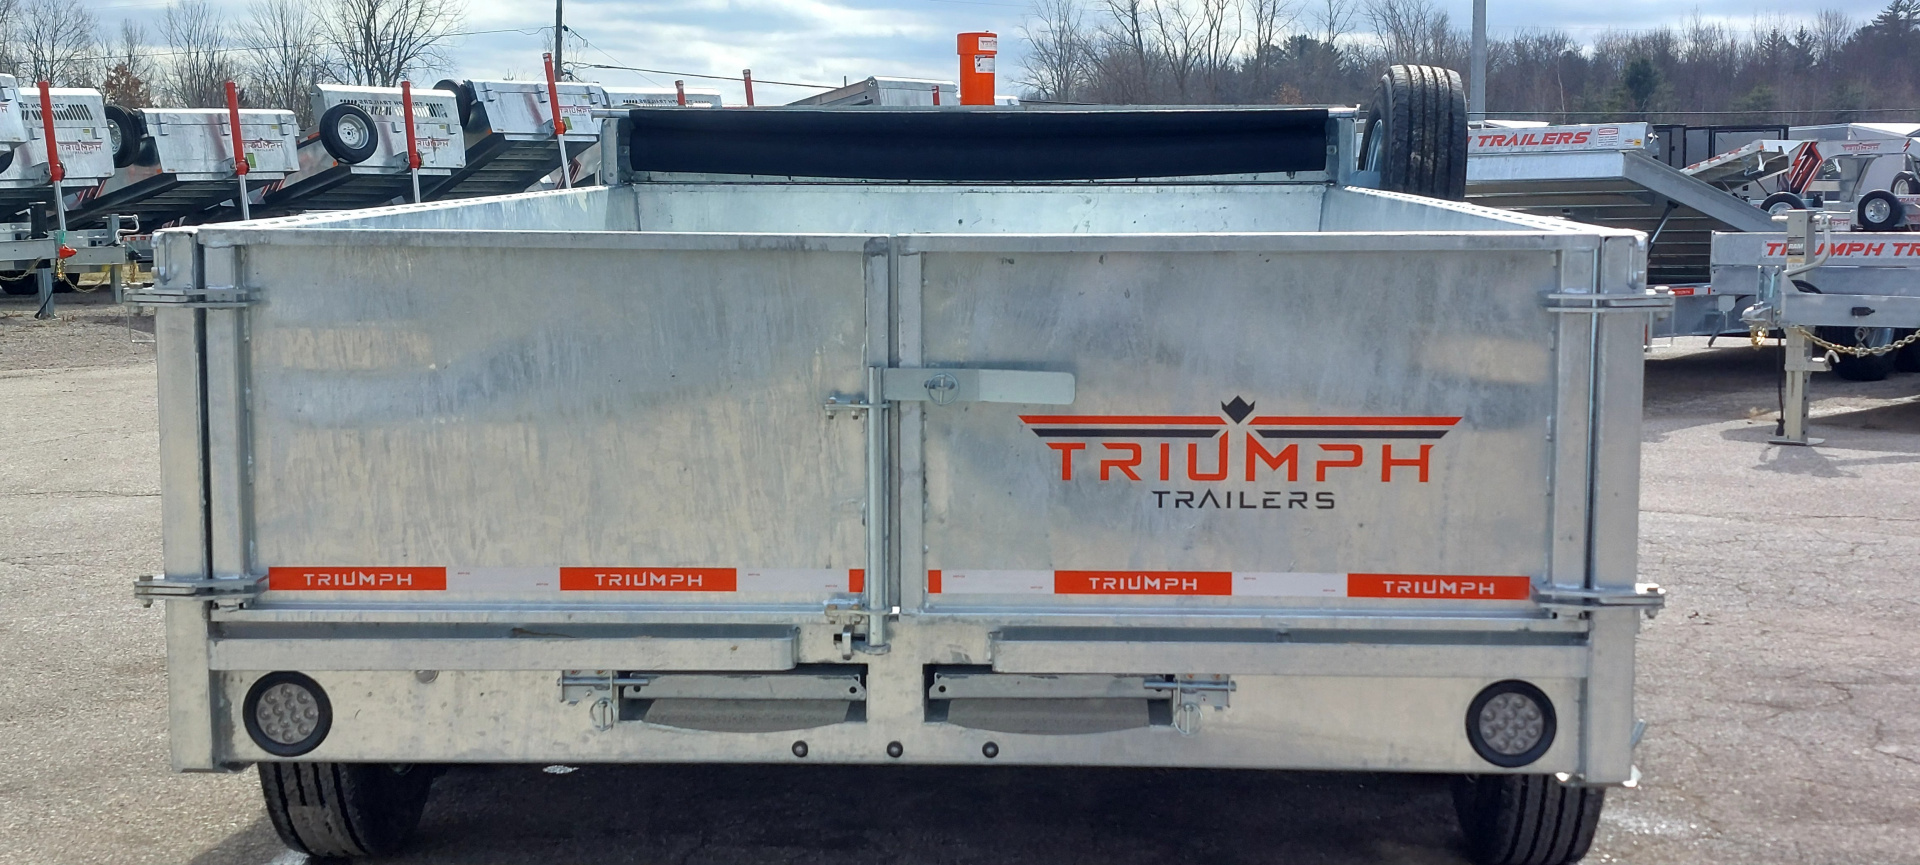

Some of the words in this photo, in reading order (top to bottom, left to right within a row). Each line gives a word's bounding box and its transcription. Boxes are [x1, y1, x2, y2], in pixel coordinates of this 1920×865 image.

[416, 140, 449, 148] RIUMPH
[1478, 131, 1592, 147] TRAILERS
[1046, 431, 1435, 483] TRIUMPH
[1151, 488, 1336, 510] TRAILERS
[303, 570, 413, 587] TRIUMPH
[594, 571, 703, 588] TRIUMPH
[1089, 575, 1198, 591] TRIUMPH
[1383, 579, 1495, 595] TRIUMPH
